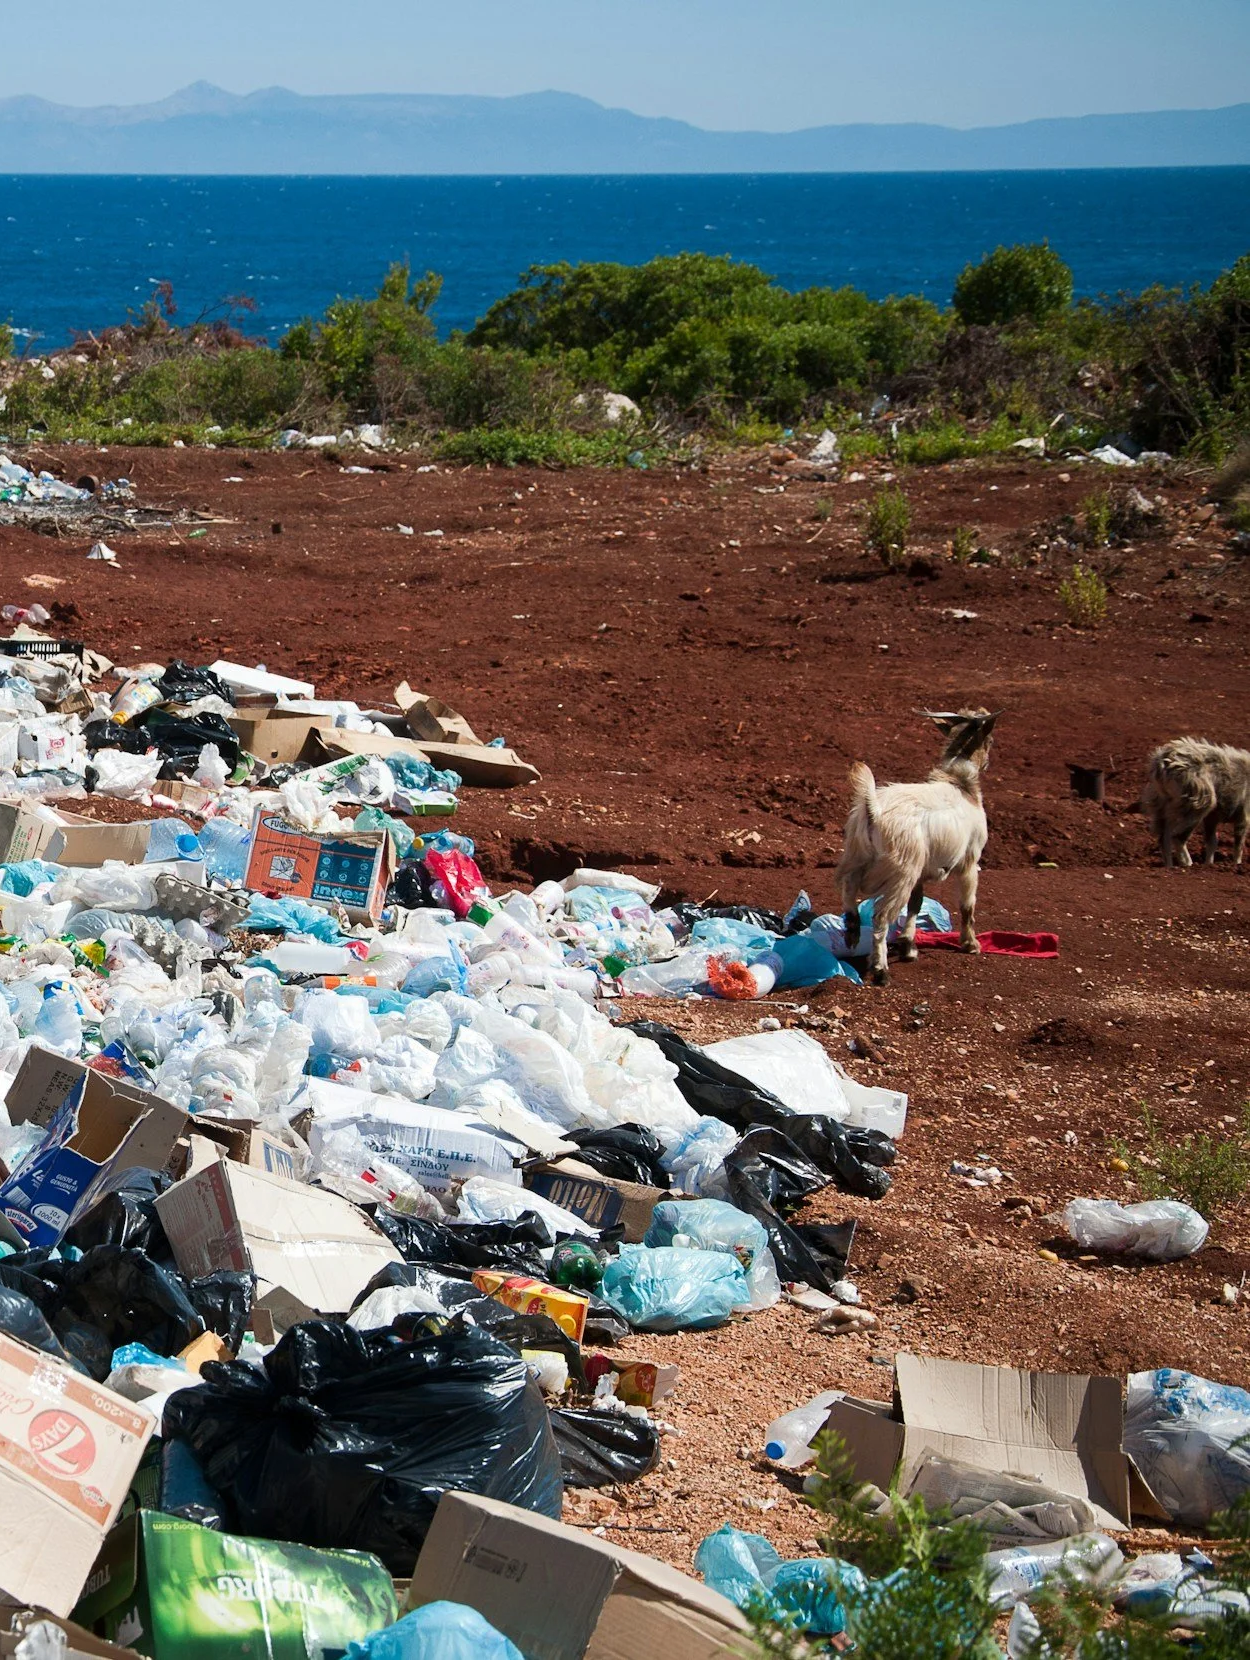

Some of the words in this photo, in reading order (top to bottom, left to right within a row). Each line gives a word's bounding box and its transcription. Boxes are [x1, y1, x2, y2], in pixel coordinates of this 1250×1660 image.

[313, 883, 365, 901] index
[410, 1159, 450, 1171] ΣΙΝΔΟΥ
[55, 1173, 73, 1184] GUSTO
[36, 1209, 53, 1222] 1000
[31, 1416, 71, 1450] DAYS
[38, 1424, 86, 1473] 7
